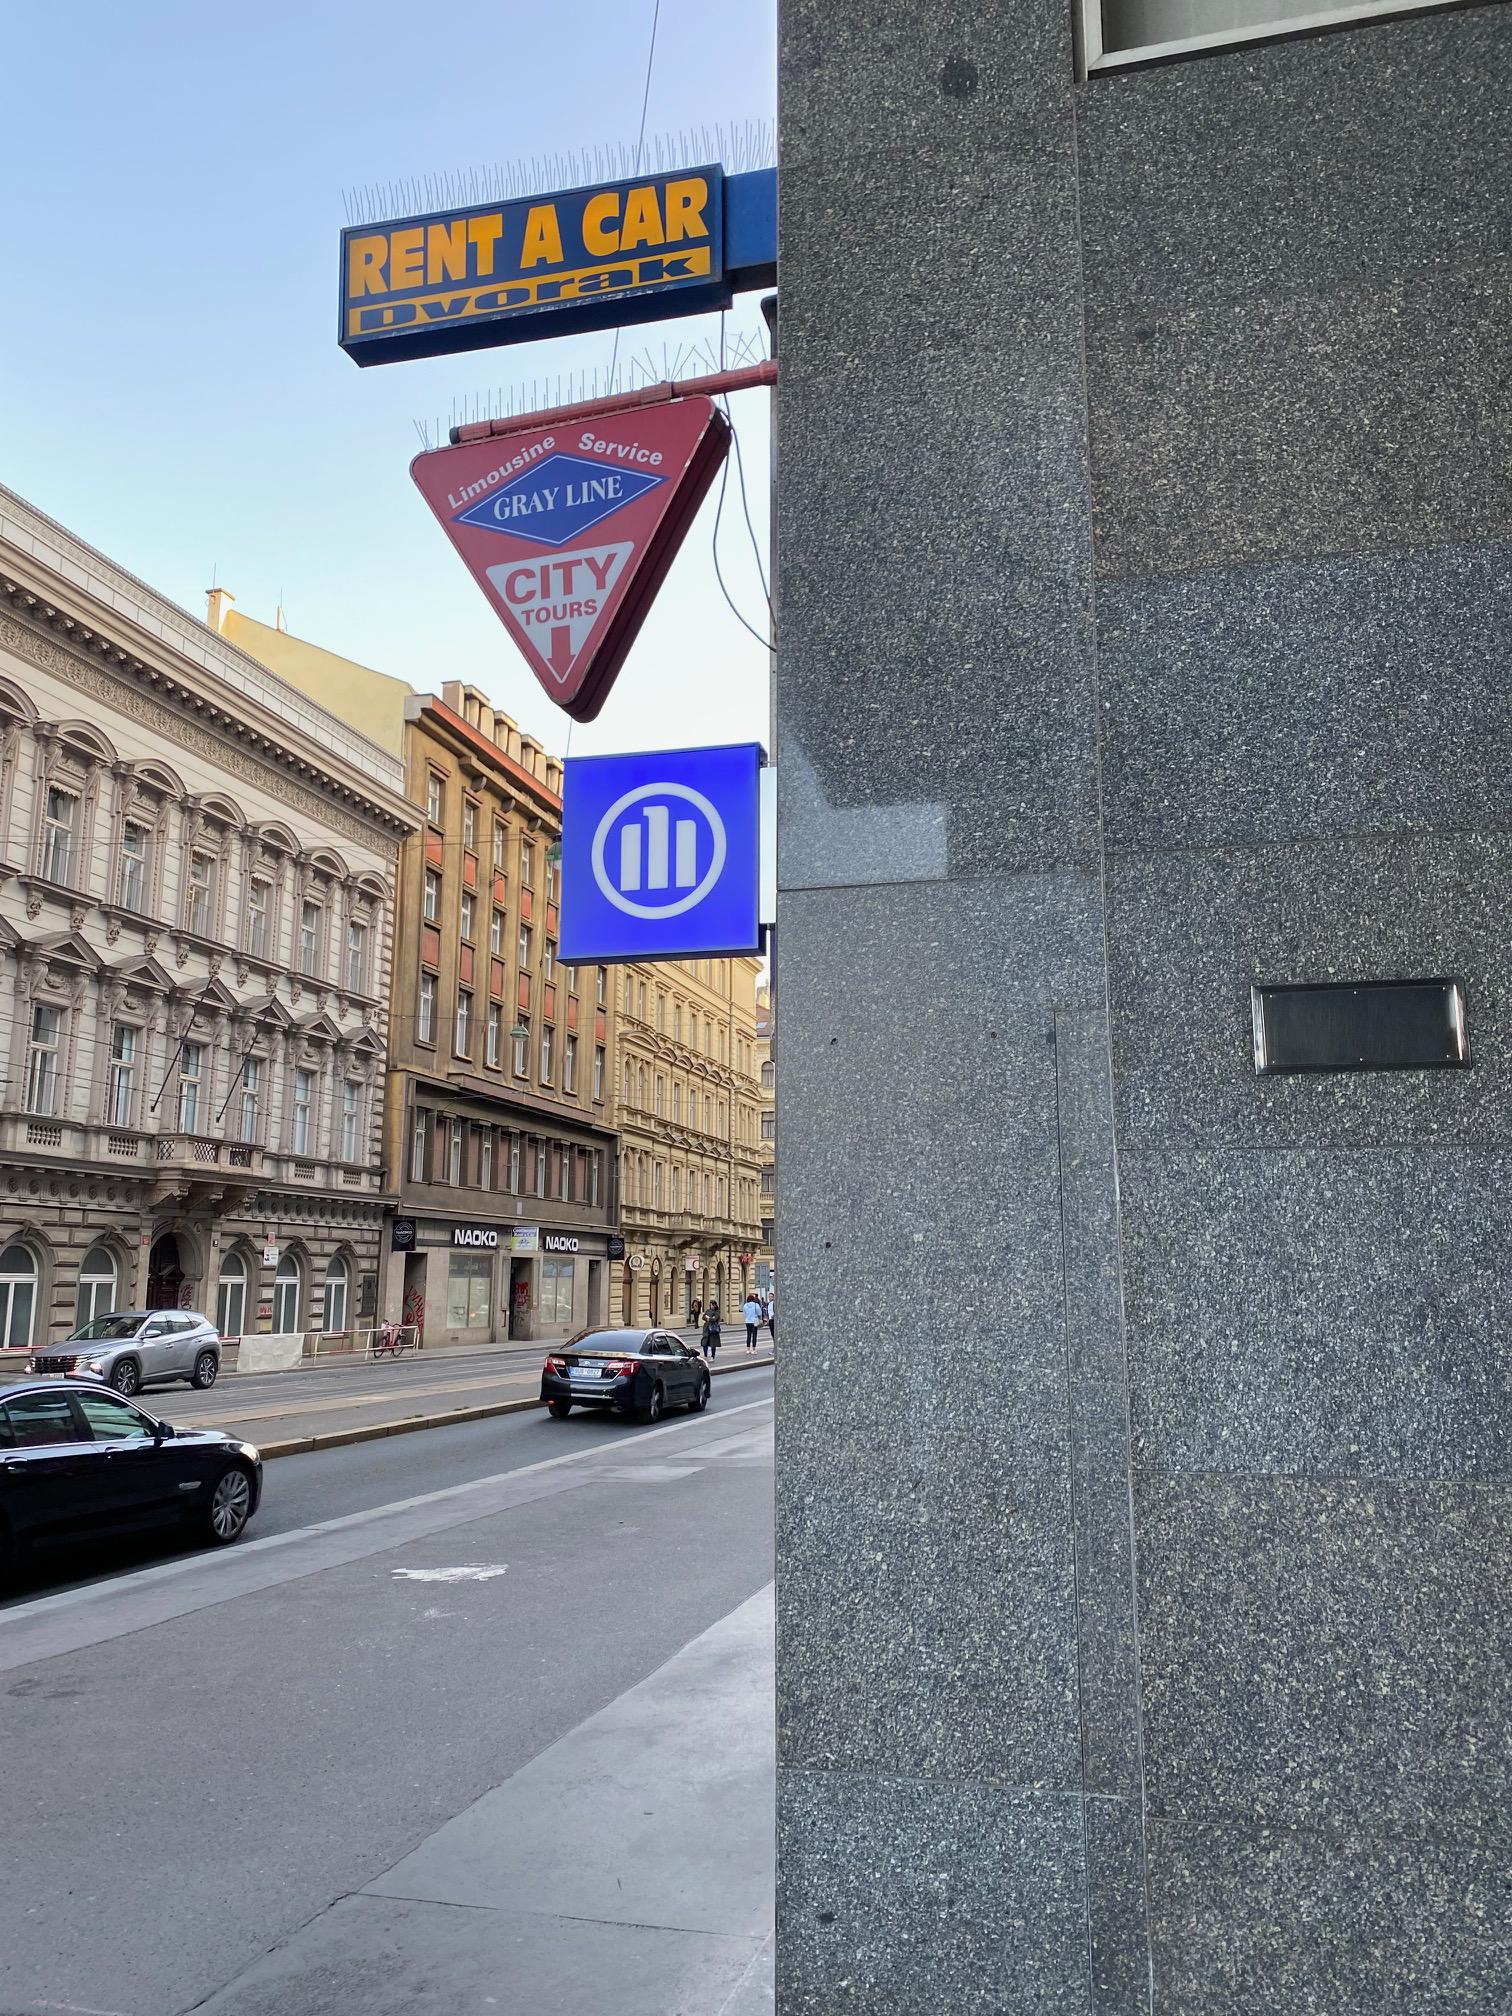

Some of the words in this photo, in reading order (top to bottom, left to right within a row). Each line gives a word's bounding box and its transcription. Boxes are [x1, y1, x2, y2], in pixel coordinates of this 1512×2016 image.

[348, 213, 503, 299] RENT
[519, 204, 564, 269] A
[582, 177, 709, 257] CAR
[360, 258, 697, 331] Dvorak
[447, 435, 556, 509] Limousine
[578, 432, 663, 466] Service
[493, 487, 560, 521] GRAY
[566, 475, 623, 508] LINE
[505, 552, 618, 605] CITY
[521, 598, 599, 627] TOURS
[454, 1228, 498, 1247] NAOKO
[545, 1236, 579, 1252] NAOKO
